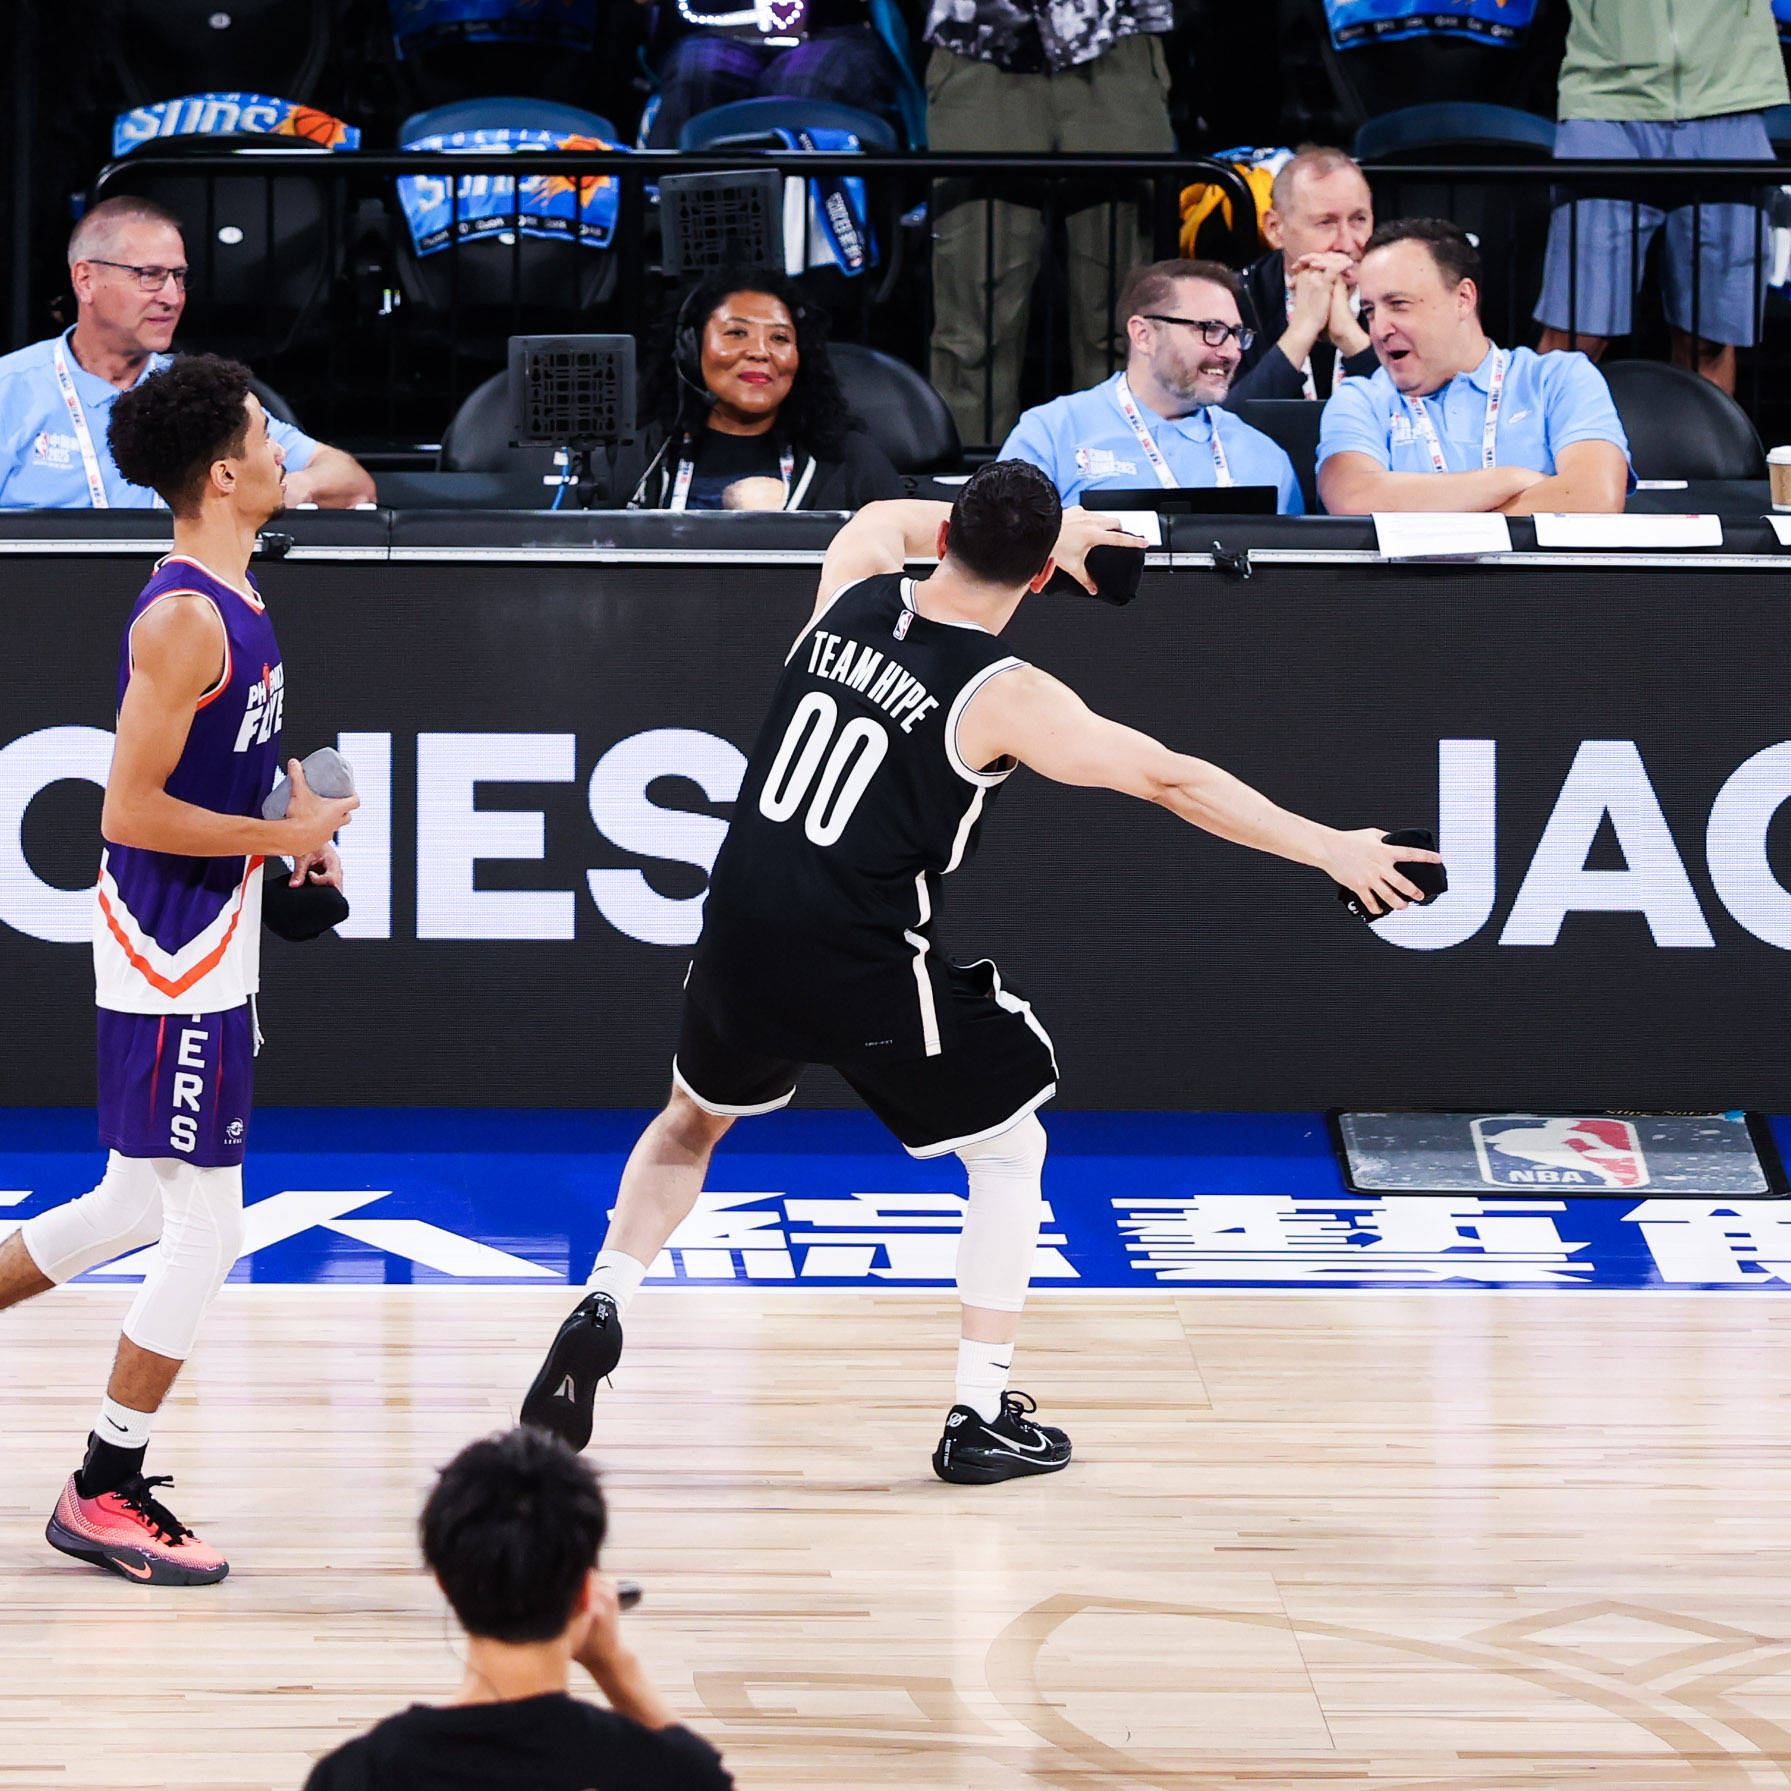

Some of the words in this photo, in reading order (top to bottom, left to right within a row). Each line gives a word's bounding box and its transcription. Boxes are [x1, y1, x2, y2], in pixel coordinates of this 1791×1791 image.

[808, 629, 879, 698] TEAM
[871, 657, 940, 736] HYPE
[758, 691, 891, 847] 00
[170, 1013, 210, 1154] ERS
[1508, 1169, 1587, 1184] NBA
